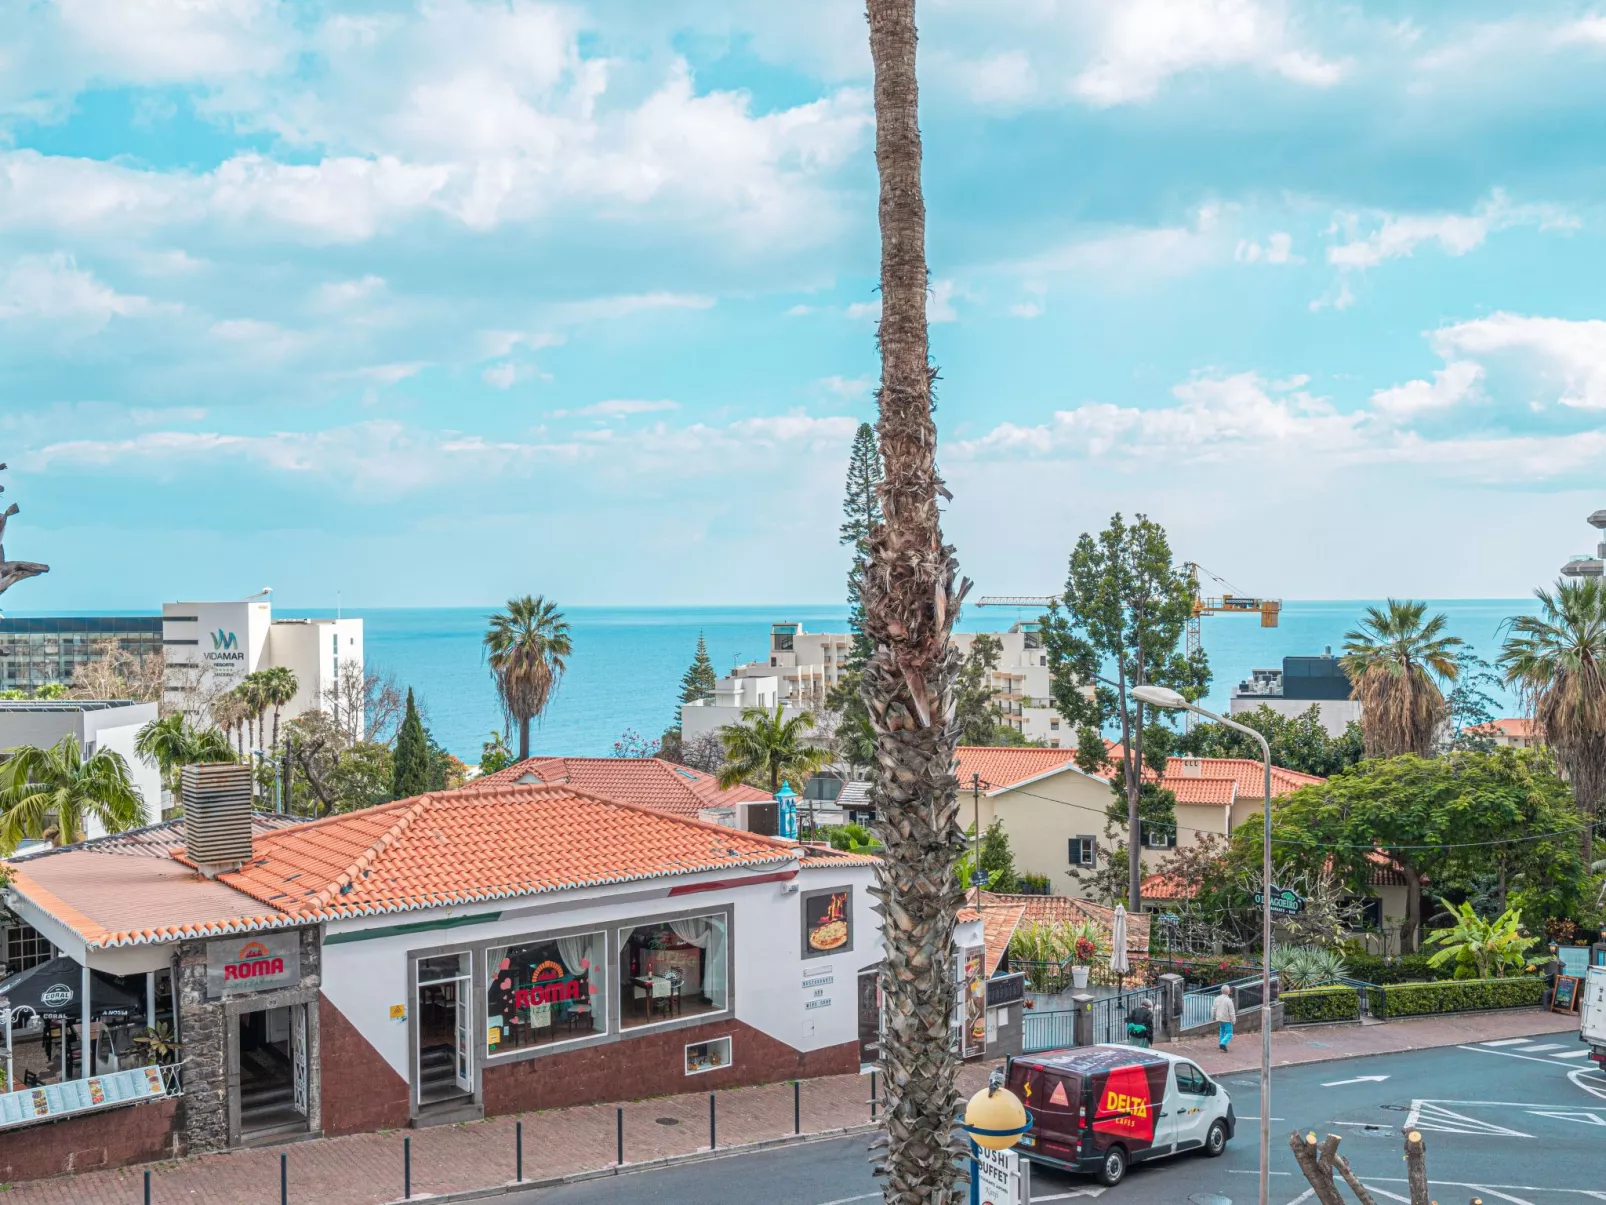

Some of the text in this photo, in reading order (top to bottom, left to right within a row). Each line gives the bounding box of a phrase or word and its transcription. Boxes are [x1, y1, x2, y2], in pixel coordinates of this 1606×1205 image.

[225, 958, 283, 980] ROMA
[45, 992, 69, 1000] CORAL
[516, 980, 579, 1008] ROMA
[1107, 1091, 1147, 1118] DELTA
